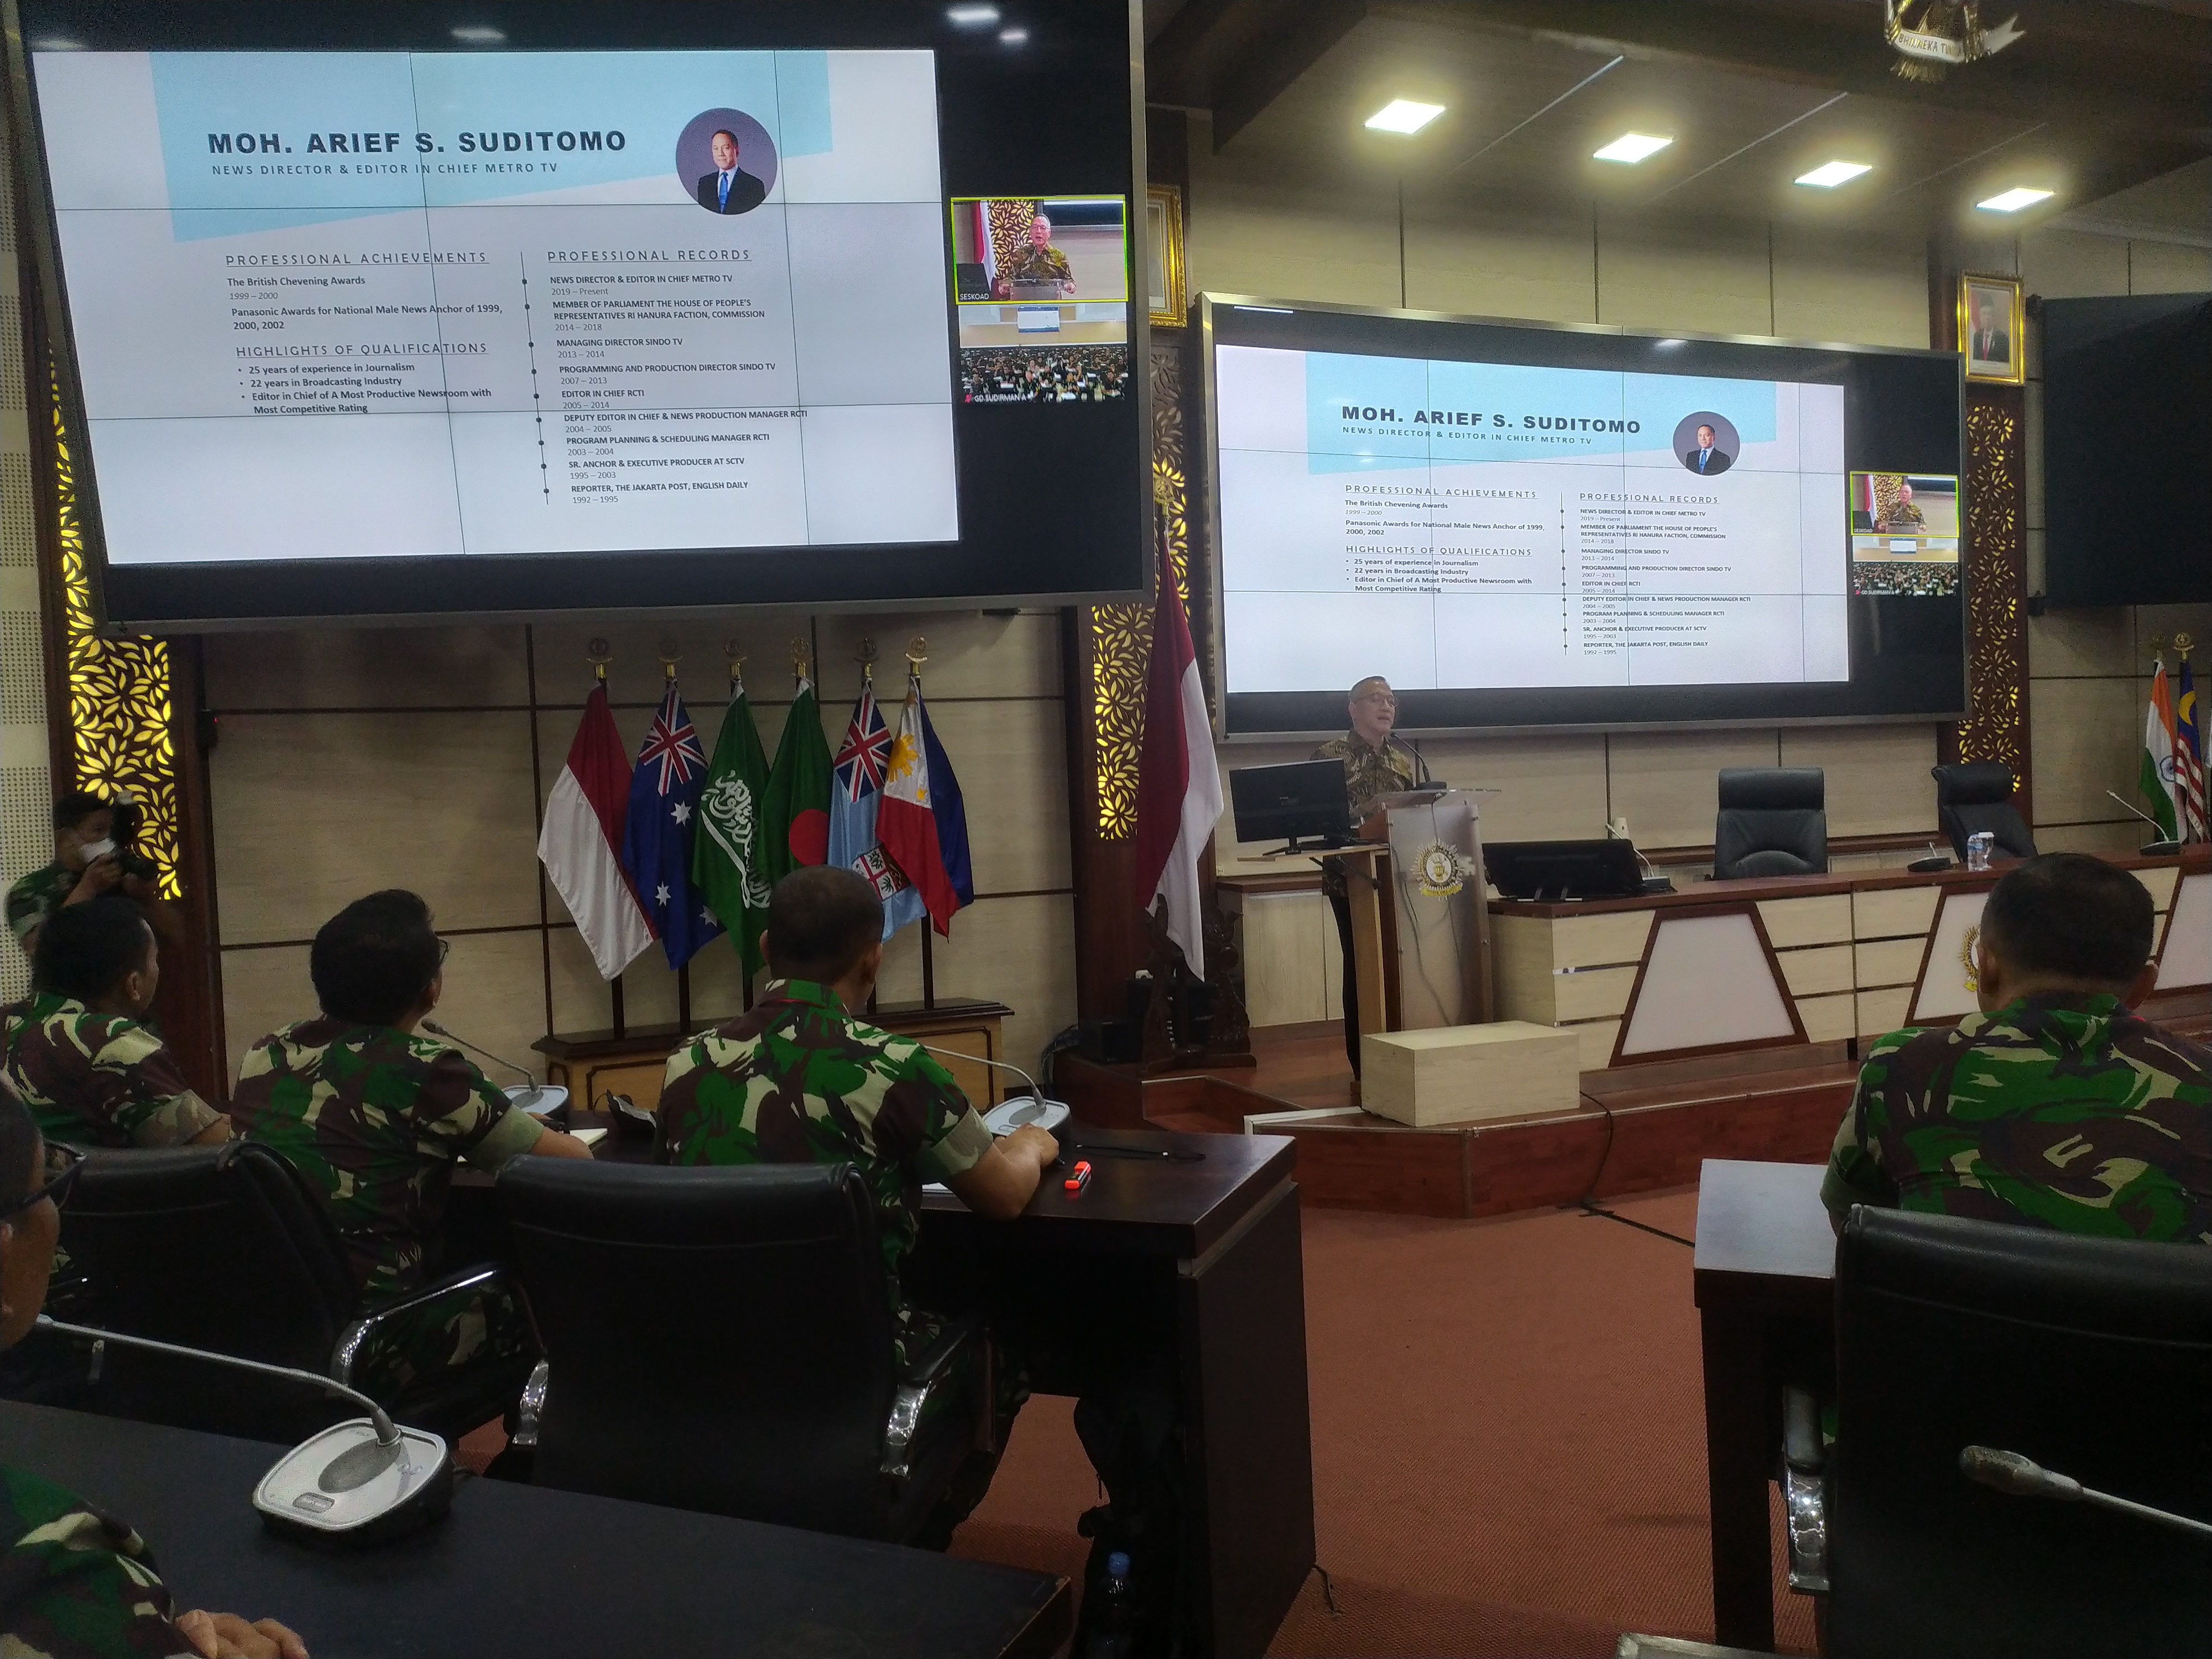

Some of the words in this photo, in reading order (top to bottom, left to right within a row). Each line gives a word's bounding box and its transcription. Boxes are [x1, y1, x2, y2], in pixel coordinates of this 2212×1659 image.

[207, 133, 291, 154] MOH.
[305, 132, 401, 153] ARIEF
[414, 132, 444, 153] S.
[458, 131, 626, 153] SUDITOMO
[212, 164, 253, 175] NEWS
[260, 164, 332, 174] DIRECTOR
[340, 164, 348, 174] &
[357, 163, 408, 174] EDITOR
[415, 163, 430, 173] IN
[438, 163, 477, 173] CHIEF
[486, 162, 534, 173] METRO
[541, 162, 557, 172] TV
[226, 254, 351, 265] PROFESSIONAL
[360, 253, 485, 264] ACHIEVEMENTS
[547, 251, 670, 262] PROFESSIONAL
[677, 251, 749, 260] RECORDS
[228, 278, 244, 286] The
[247, 277, 278, 286] British
[279, 276, 328, 288] Chevening
[330, 276, 365, 285] Awards
[231, 307, 278, 316] Panasonic
[280, 306, 315, 316] Awards
[317, 305, 331, 315] for
[333, 305, 373, 315] National
[375, 305, 399, 314] Male
[401, 304, 427, 314] News
[429, 304, 463, 314] Anchor
[465, 303, 474, 313] of
[477, 303, 502, 314] 1999,
[674, 311, 709, 320] FACTION,
[233, 321, 259, 332] 2000,
[262, 321, 284, 330] 2002
[236, 346, 327, 357] HIGHLIGHTS
[335, 345, 353, 355] OF
[361, 343, 486, 356] QUALIFICATIONS
[248, 365, 260, 374] 25
[262, 367, 288, 376] years
[289, 364, 299, 373] of
[301, 366, 352, 375] experience
[354, 363, 363, 372] in
[365, 362, 415, 372] Journalism
[250, 378, 262, 388] 22
[264, 380, 289, 390] years
[291, 378, 300, 387] in
[302, 377, 362, 389] Broadcasting
[364, 377, 402, 388] Industry
[252, 392, 280, 401] Editor
[282, 391, 291, 400] in
[293, 391, 317, 400] Chief
[319, 390, 329, 400] of
[331, 390, 338, 400] A
[340, 390, 364, 399] Most
[366, 389, 415, 399] Productive
[418, 388, 468, 398] Newsroom
[471, 388, 491, 398] with
[253, 405, 278, 414] Most
[280, 404, 336, 416] Competitive
[338, 403, 368, 415] Rating
[748, 410, 789, 419] MANAGER
[1342, 406, 1402, 423] MOH.
[1413, 409, 1482, 426] ARIEF
[1493, 413, 1512, 428] S.
[1524, 414, 1640, 434] SUDITOMO
[1379, 429, 1431, 437] DIRECTOR
[1448, 432, 1486, 440] EDITOR
[571, 484, 613, 493] REPORTER,
[632, 483, 666, 491] JAKARTA
[668, 482, 690, 491] POST,
[1345, 485, 1439, 495] PROFESSIONAL
[1446, 488, 1537, 498] ACHIEVEMENTS
[1580, 493, 1664, 502] PROFESSIONAL
[1670, 495, 1718, 503] RECORDS
[1384, 500, 1420, 510] Chevening
[1346, 545, 1416, 554] HIGHLIGHTS
[1420, 546, 1434, 555] OF
[1440, 547, 1532, 556] QUALIFICATIONS
[1394, 567, 1438, 576] Broadcasting
[1441, 568, 1468, 577] Industry
